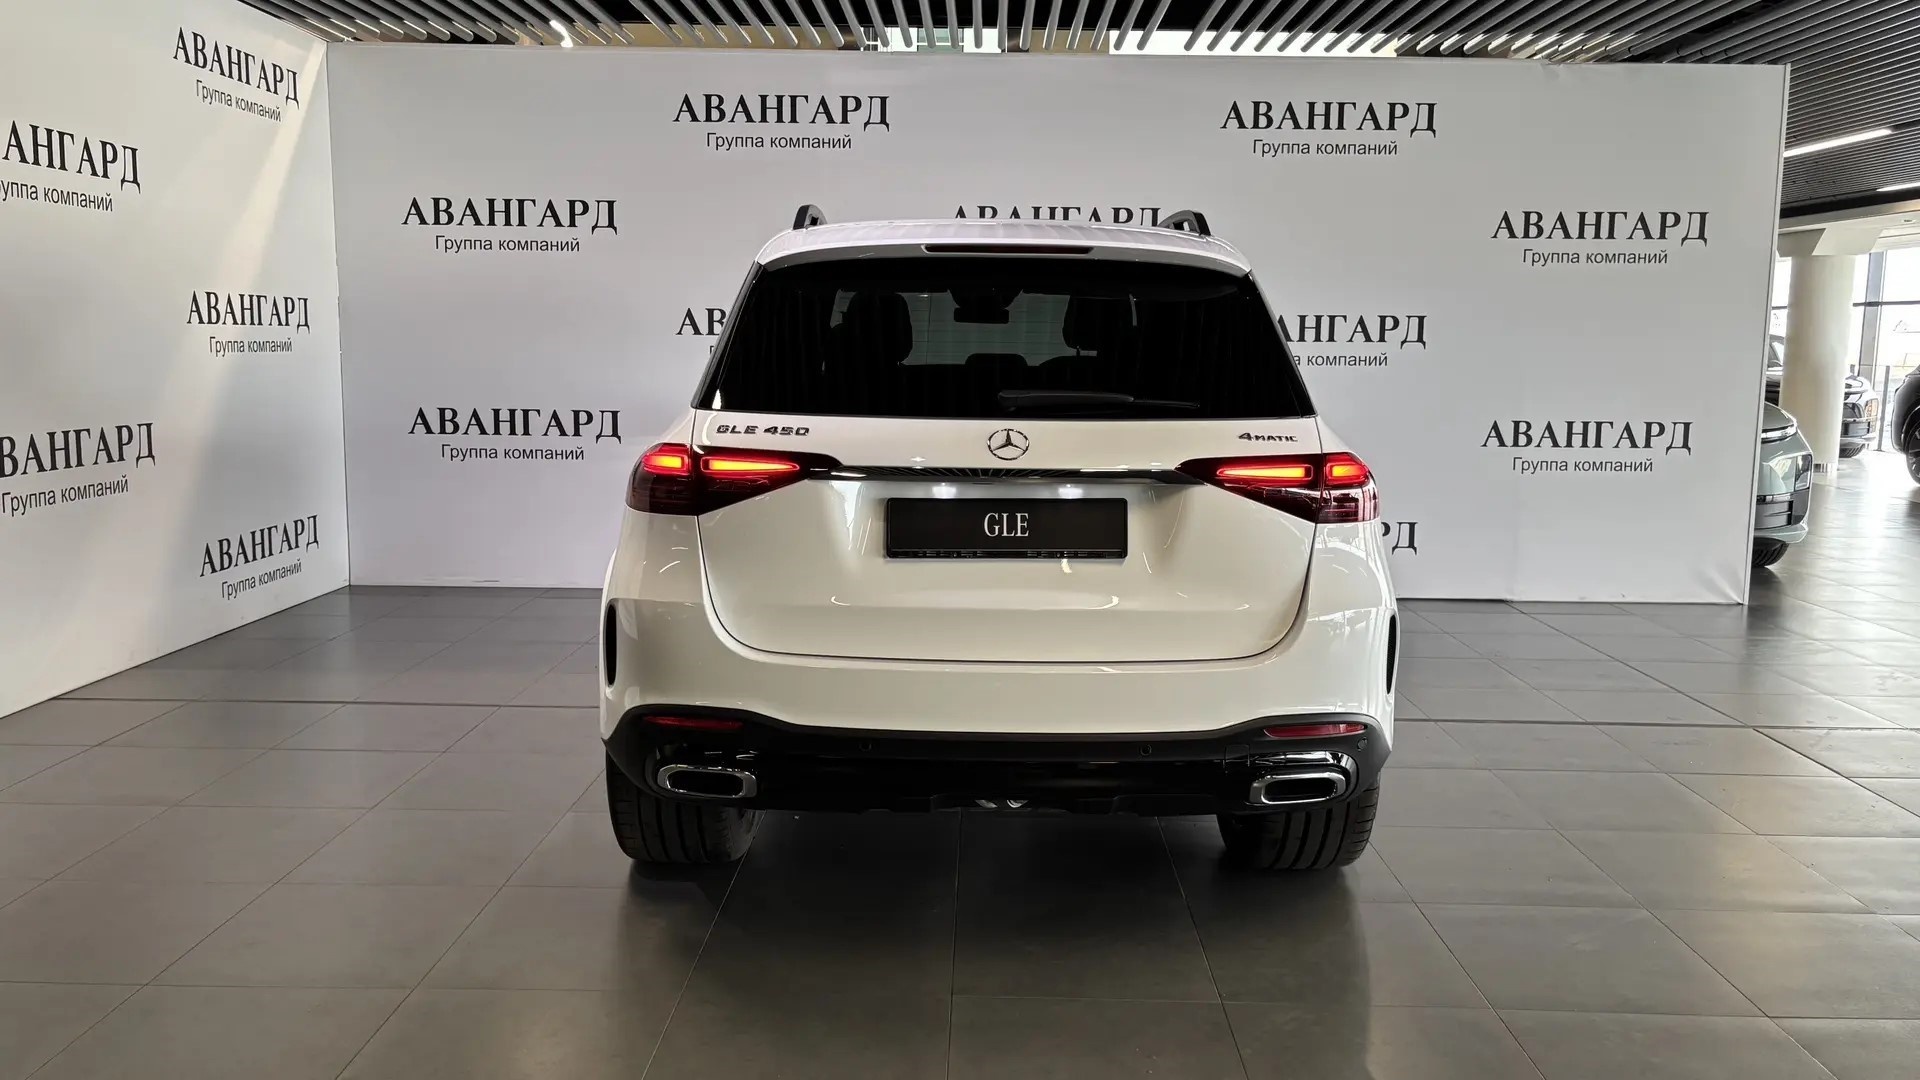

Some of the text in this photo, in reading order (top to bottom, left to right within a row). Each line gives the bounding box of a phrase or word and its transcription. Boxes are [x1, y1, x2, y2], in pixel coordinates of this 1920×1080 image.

[173, 27, 300, 109] АВАНГАРД
[195, 79, 281, 123] Группа компаний
[673, 93, 890, 133] АВАНГАРД
[1220, 100, 1438, 139] АВАНГАРД
[706, 132, 852, 151] Группа компаний
[1253, 139, 1398, 158] Группа компаний
[0, 179, 113, 212] уппа компаний
[401, 196, 618, 236] АВАНГАРД
[1490, 210, 1710, 248] АВАНГАРД
[435, 235, 580, 253] Группа компаний
[1523, 248, 1668, 267] Группа компаний
[187, 290, 311, 335] АВАНГАРД
[209, 336, 292, 357] Группа компаний
[1277, 314, 1428, 350] АНГАРД
[1307, 352, 1388, 367] компаний
[408, 406, 622, 445] АВАНГАРД
[716, 424, 810, 437] GLE 450
[1238, 432, 1299, 442] 4MATIC
[1480, 419, 1694, 457] АВАНГАРД
[441, 444, 585, 462] Группа компаний
[1512, 456, 1653, 475] Группа компаний
[2, 473, 129, 517] Группа компаний
[983, 512, 1030, 538] GLE
[200, 514, 320, 578] АВАНГАРД
[221, 557, 302, 600] Группа компаний
